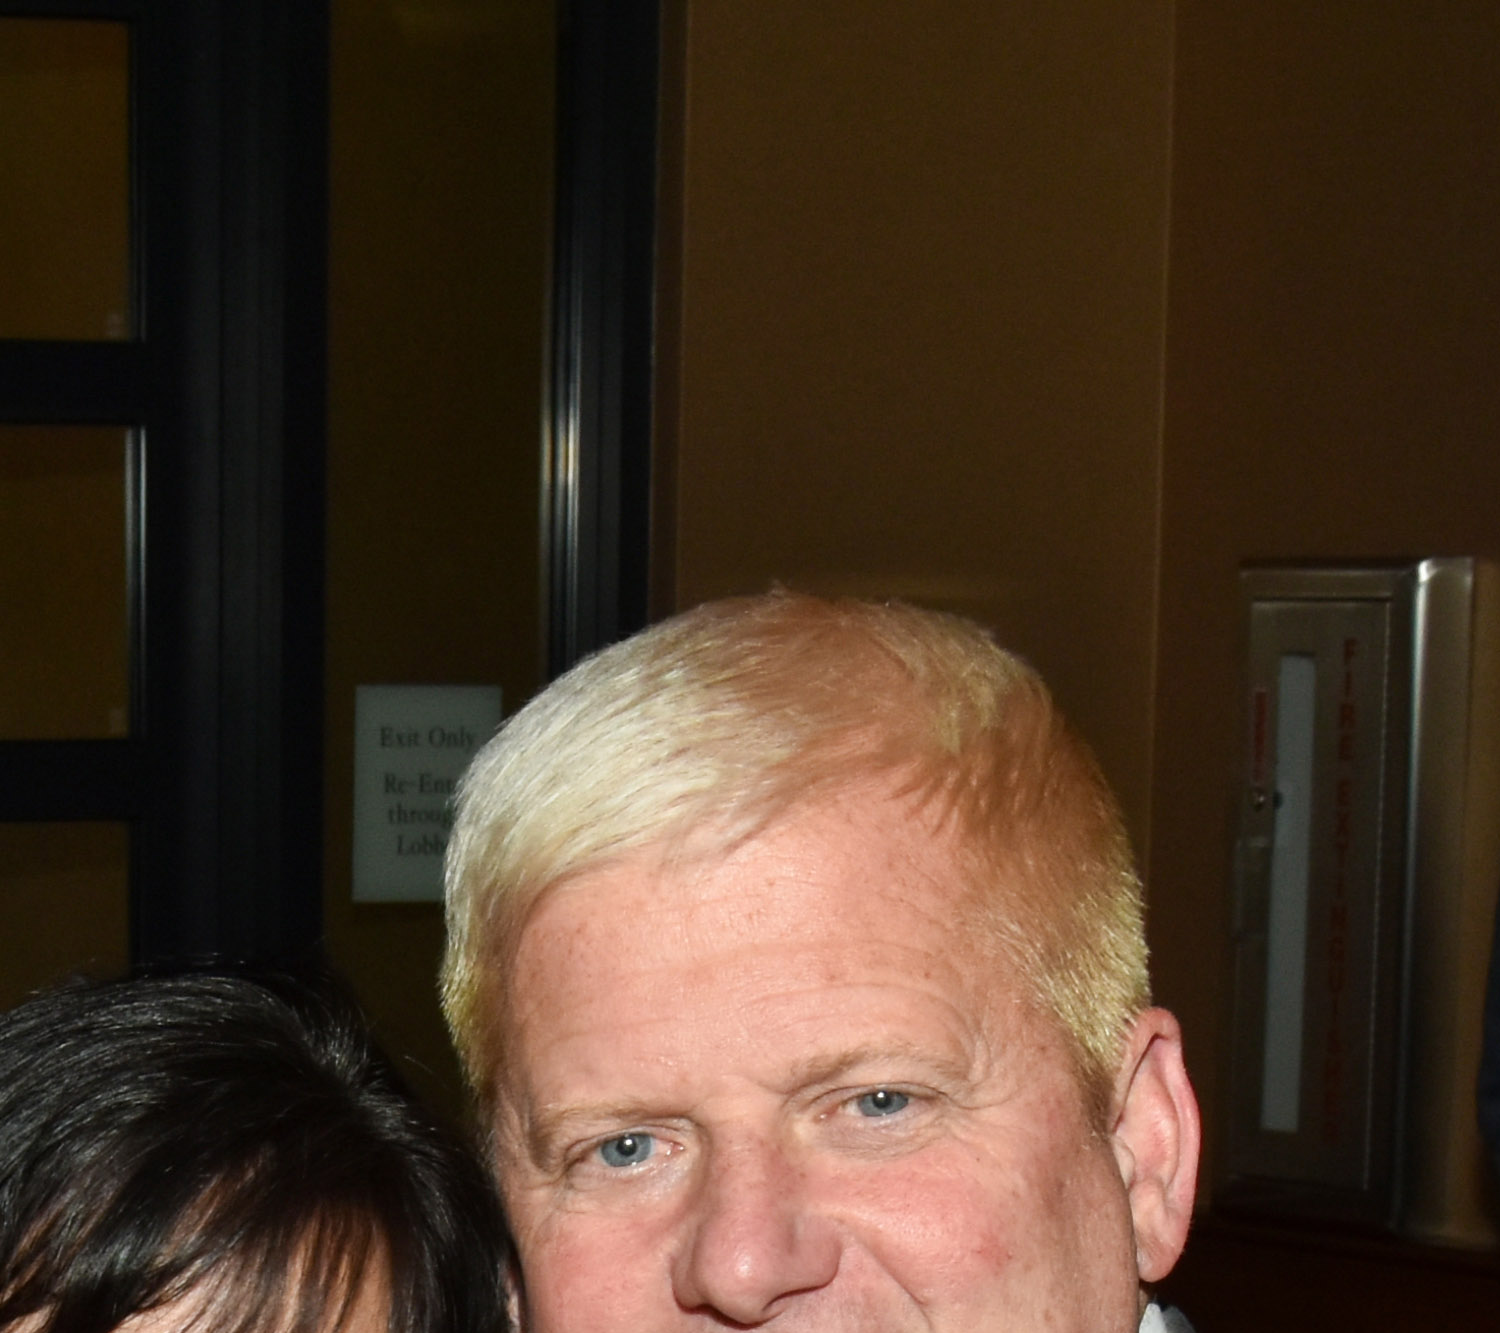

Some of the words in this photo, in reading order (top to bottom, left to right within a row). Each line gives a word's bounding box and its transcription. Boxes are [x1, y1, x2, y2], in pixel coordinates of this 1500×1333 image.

[1338, 637, 1358, 761] FIRE
[379, 726, 420, 748] Exit
[428, 726, 475, 754] Only
[396, 834, 447, 857] Lobb
